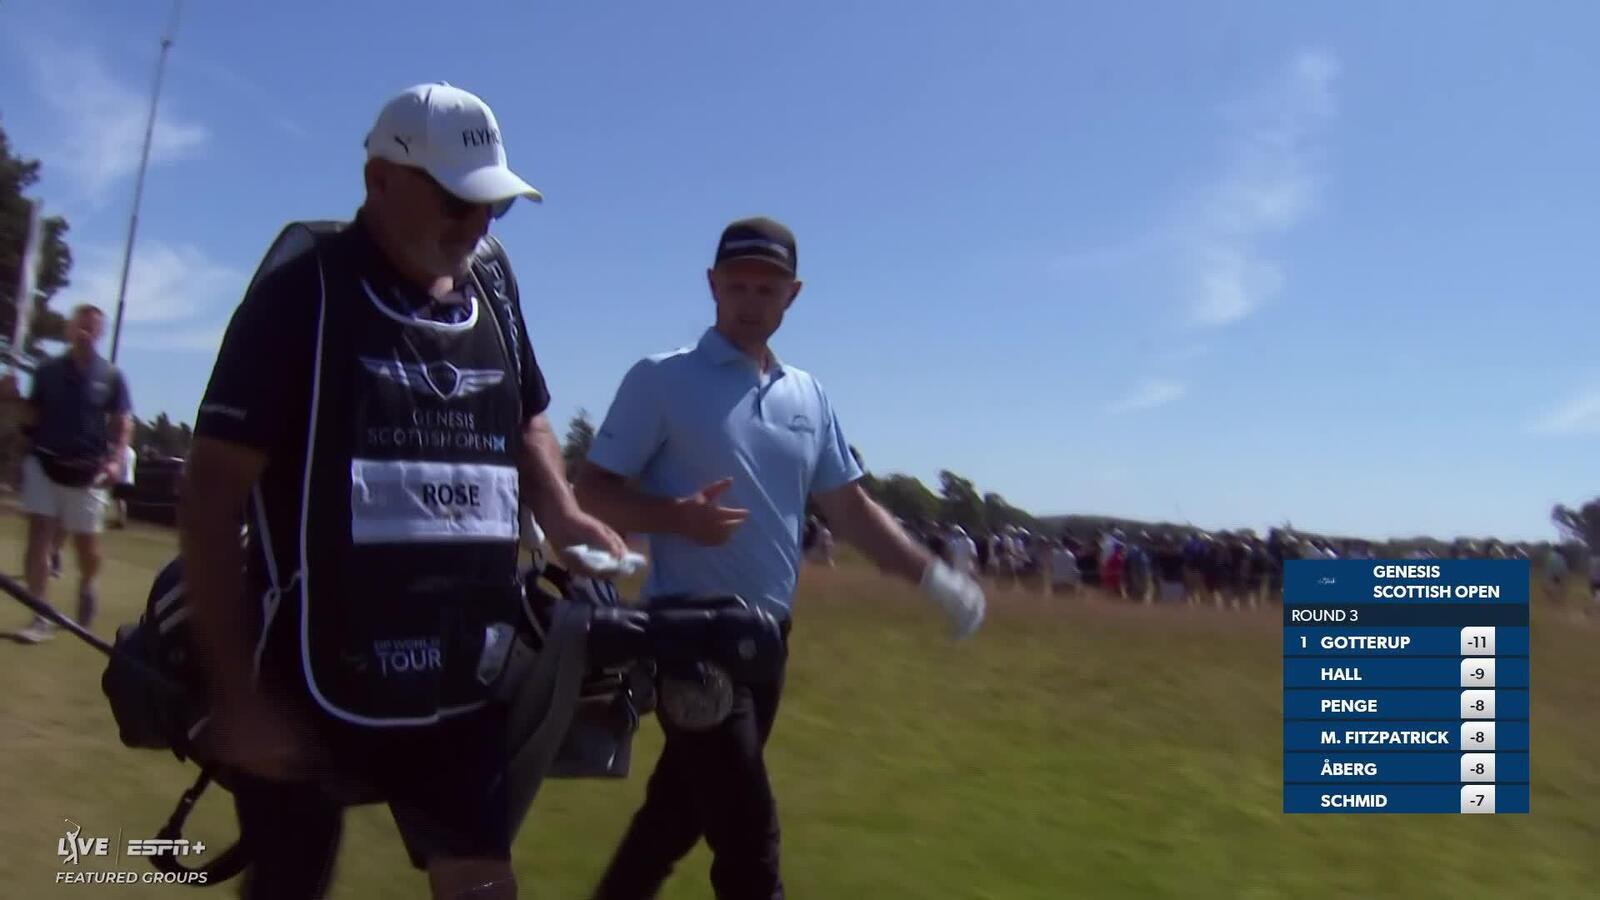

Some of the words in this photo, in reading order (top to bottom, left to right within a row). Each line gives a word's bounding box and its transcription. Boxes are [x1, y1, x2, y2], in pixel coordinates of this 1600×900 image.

[412, 409, 475, 430] GENESIS
[367, 427, 451, 448] SCOTTISH
[422, 483, 481, 507] ROSE
[375, 648, 442, 677] TOUR
